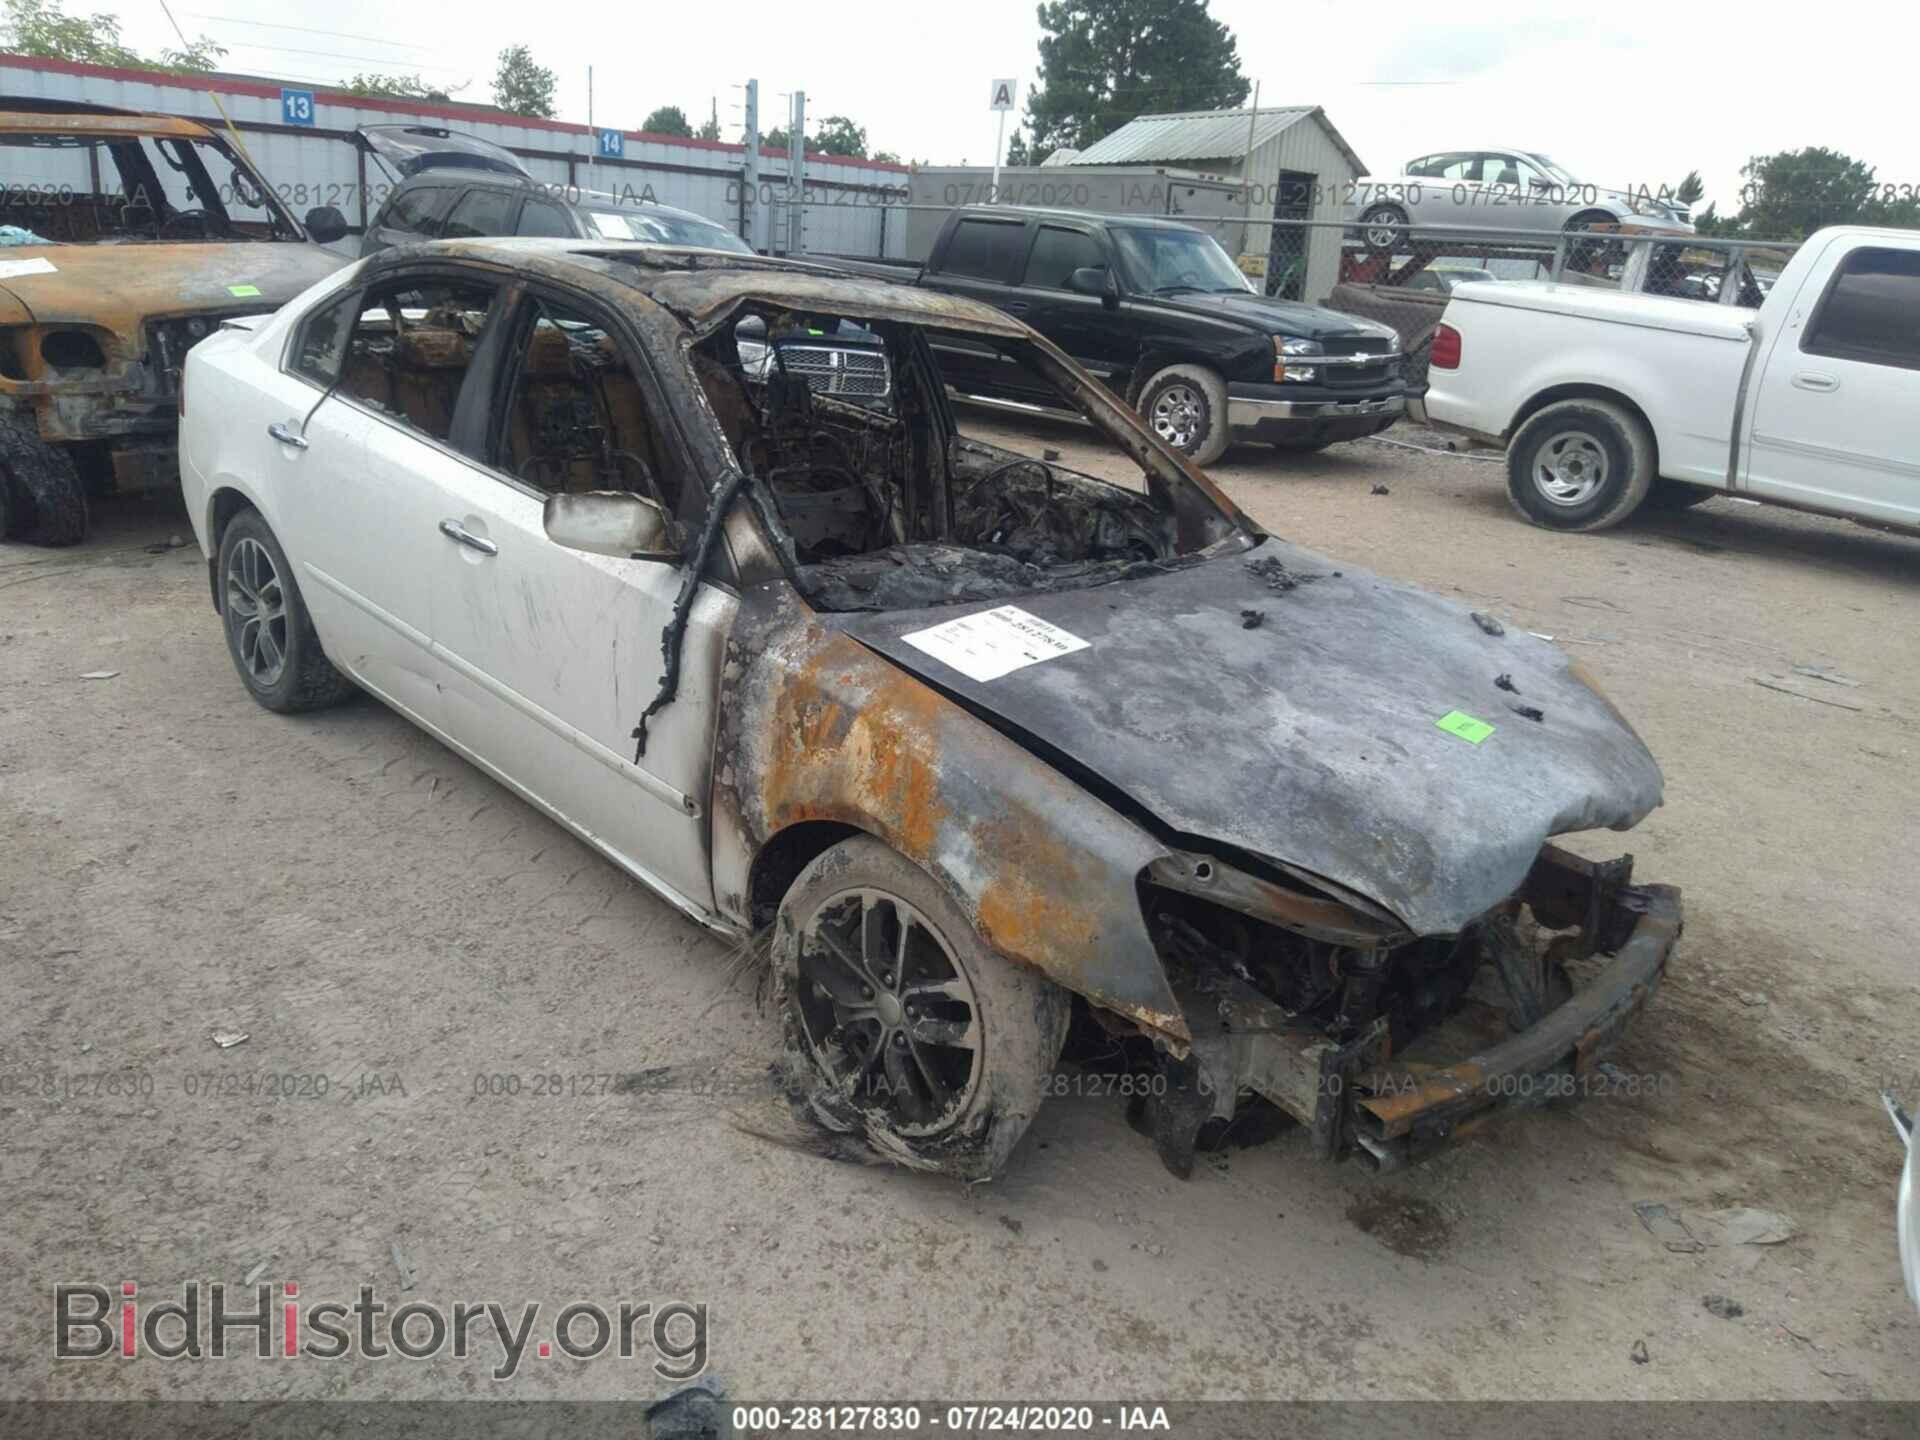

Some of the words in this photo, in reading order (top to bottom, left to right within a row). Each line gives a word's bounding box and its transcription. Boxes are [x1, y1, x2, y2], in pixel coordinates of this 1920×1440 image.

[993, 84, 1011, 105] A
[287, 96, 310, 119] 13
[603, 133, 620, 153] 14
